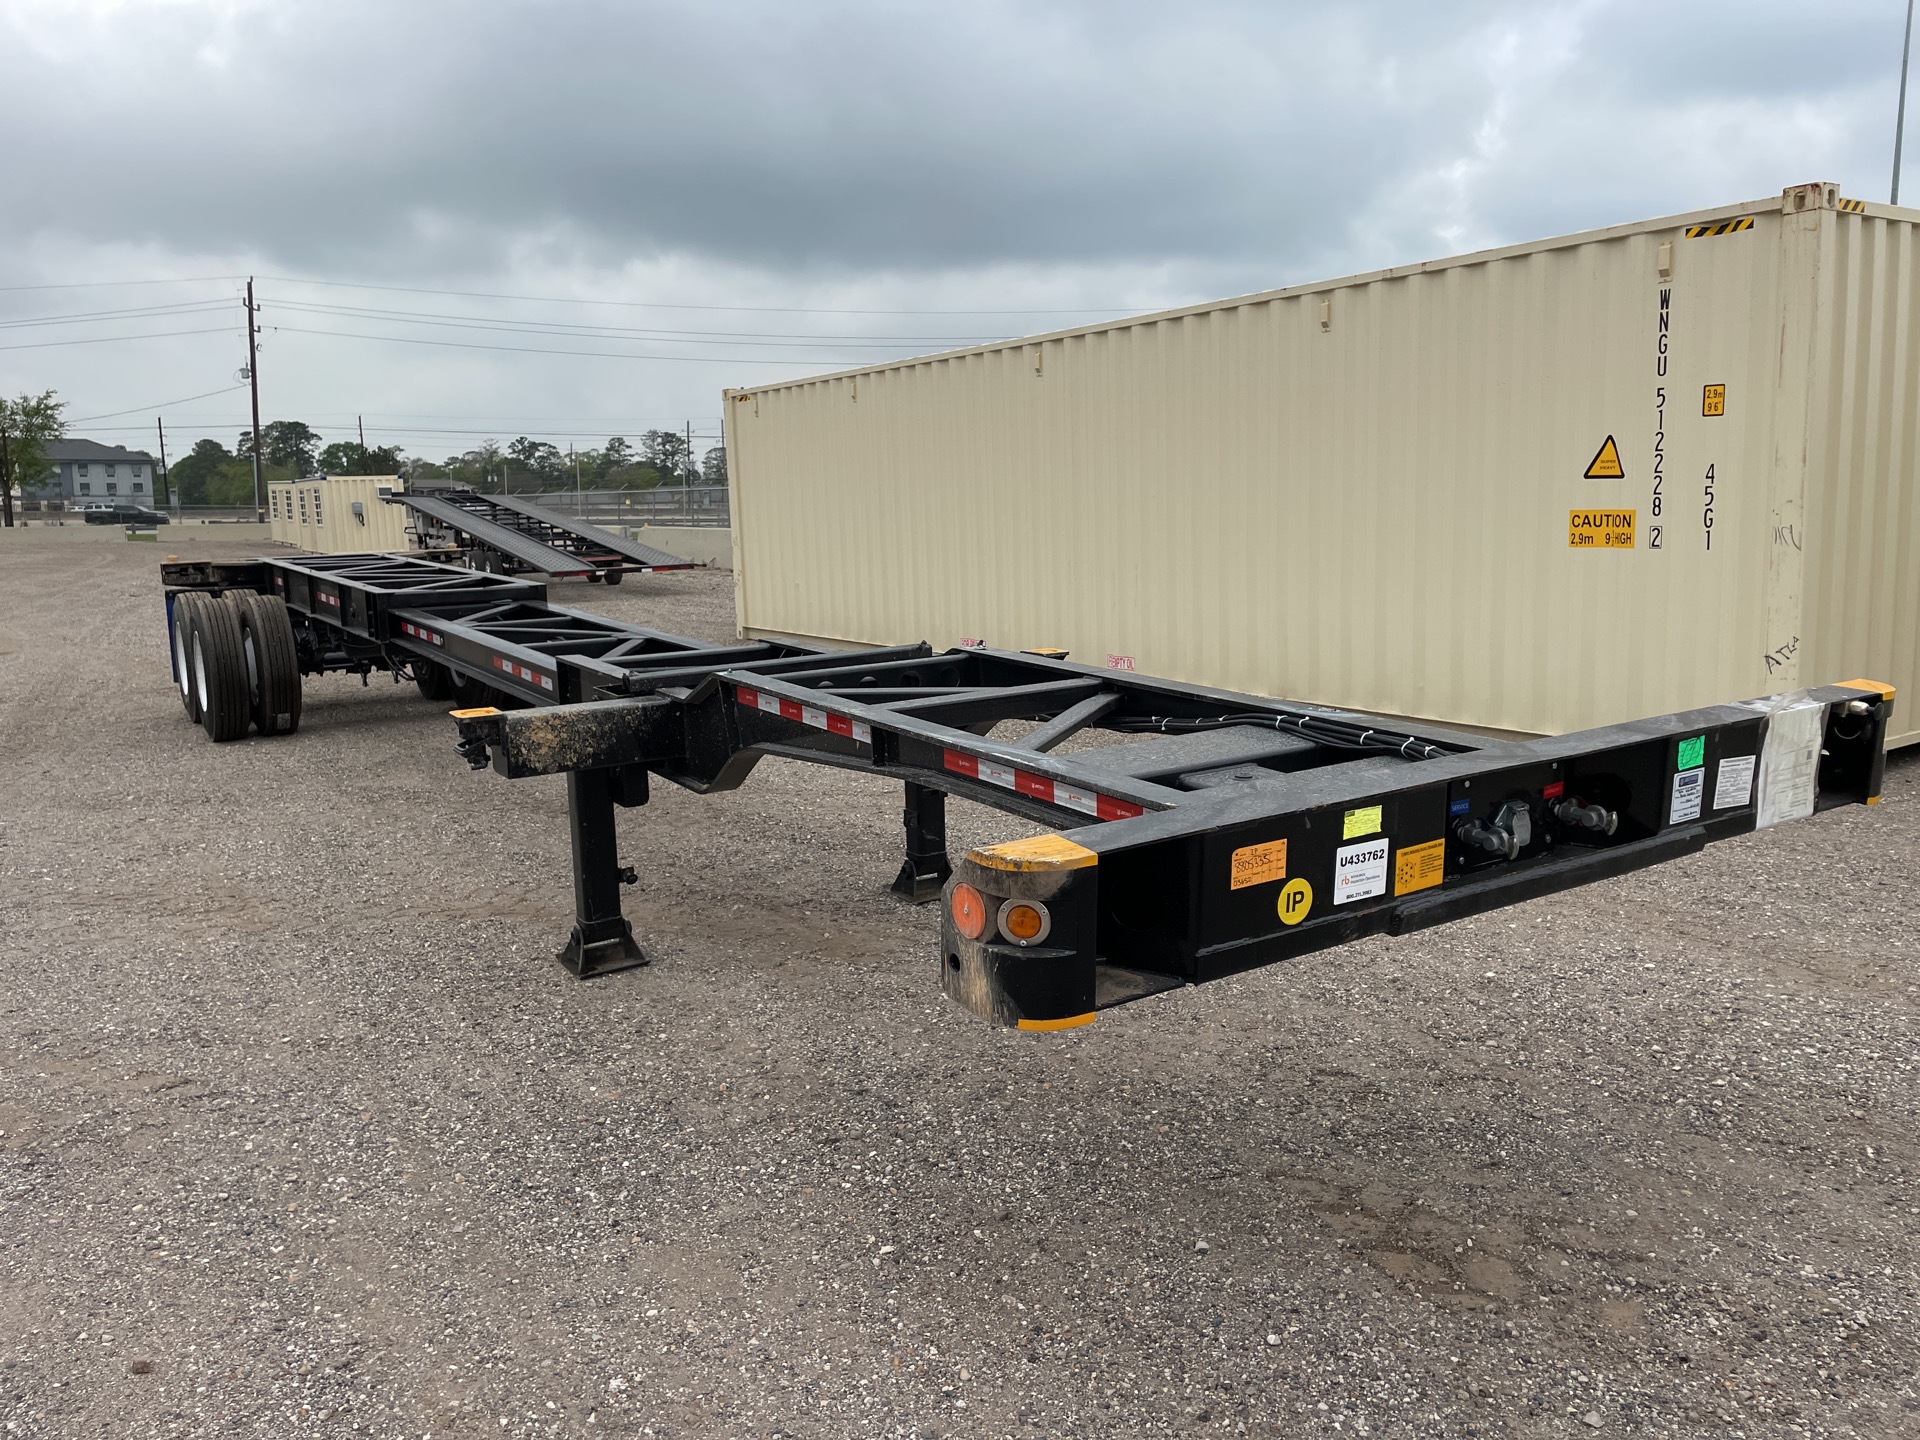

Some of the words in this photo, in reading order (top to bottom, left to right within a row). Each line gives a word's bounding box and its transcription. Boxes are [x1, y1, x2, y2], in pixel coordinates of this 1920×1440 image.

[1657, 288, 1671, 377] WNGU
[1652, 387, 1666, 517] 512228
[1703, 463, 1715, 551] 45G1
[1571, 513, 1632, 528] CAUTION
[1651, 528, 1661, 548] 2
[1452, 802, 1469, 811] SERVICE
[1340, 848, 1385, 867] U433762
[1341, 875, 1350, 885] rb
[1286, 890, 1305, 914] IP
